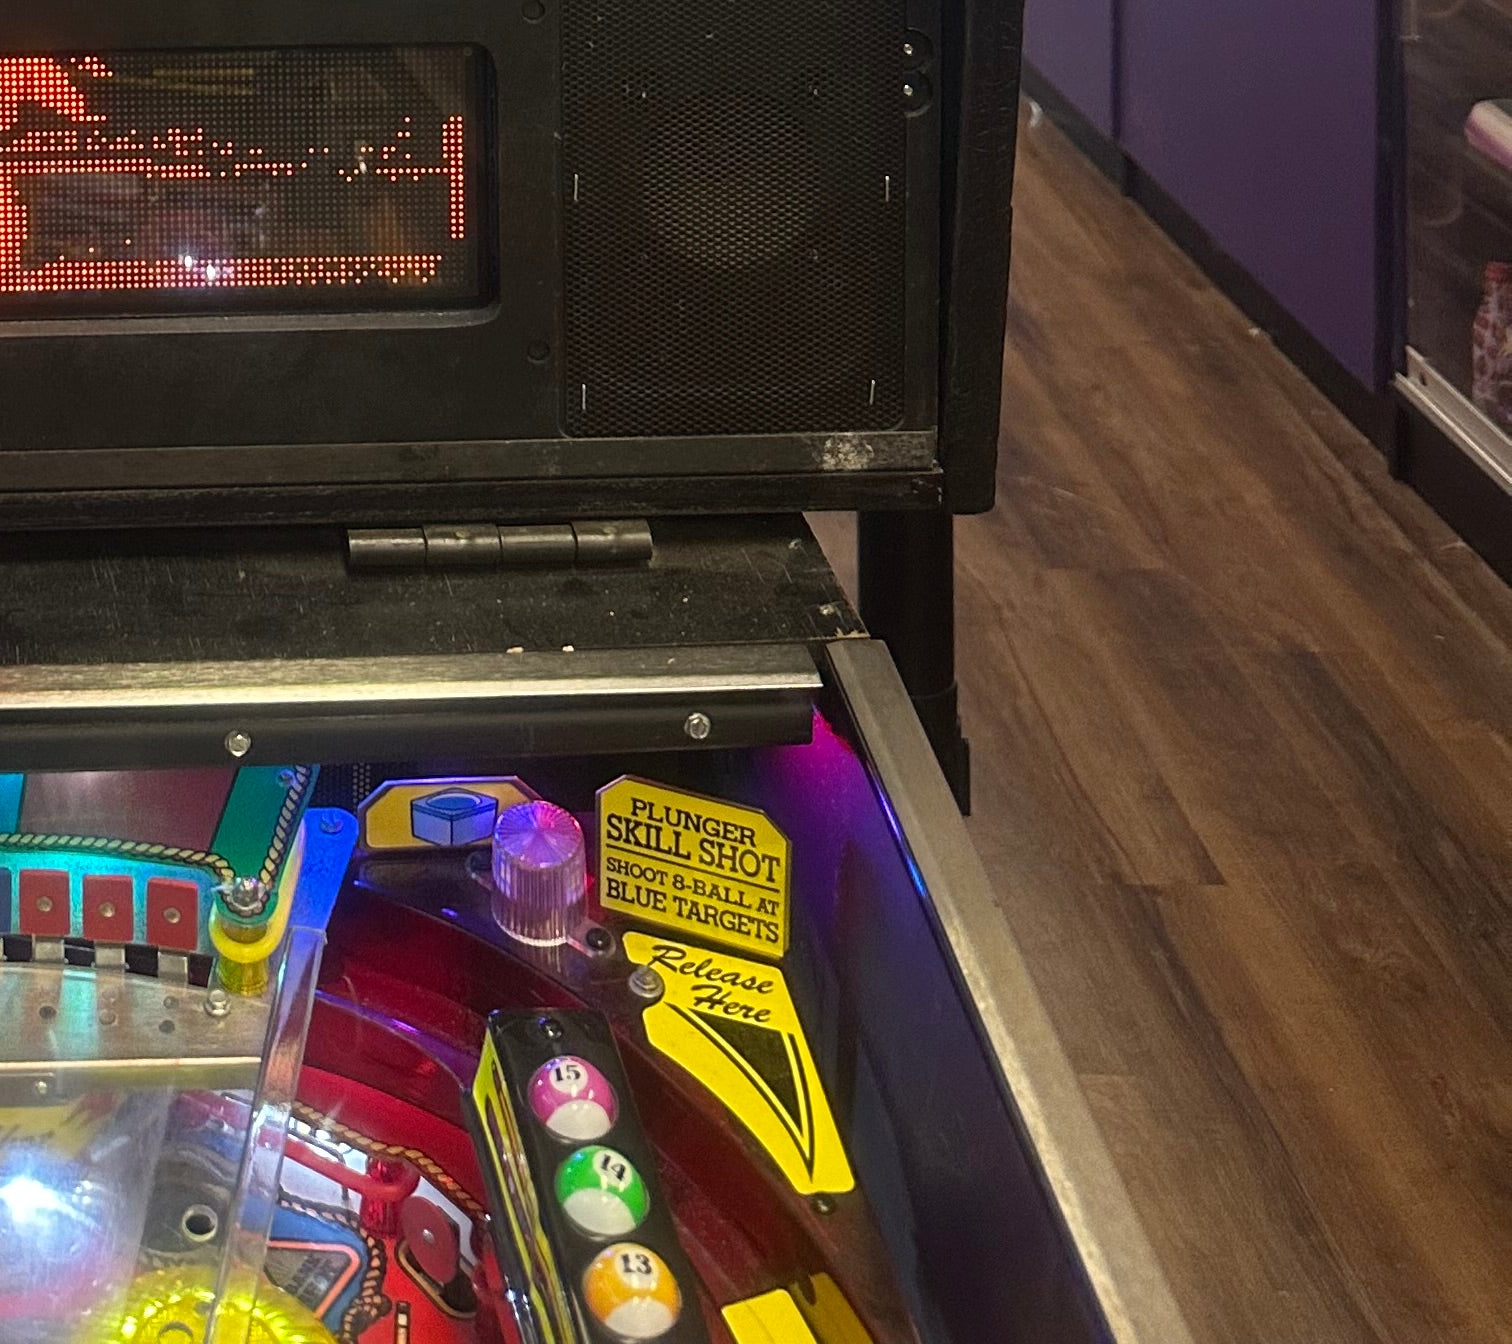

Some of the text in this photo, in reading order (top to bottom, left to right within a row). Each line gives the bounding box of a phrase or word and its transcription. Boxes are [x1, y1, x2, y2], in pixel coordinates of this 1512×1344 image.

[606, 813, 781, 883] SKILL SHOT
[631, 797, 756, 848] PLUNGER
[606, 856, 780, 917] SHOOT 8-BALL AT
[606, 876, 780, 944] BLUE TARGETS
[647, 943, 774, 995] Release
[690, 983, 772, 1023] Here
[553, 1064, 582, 1083] 15
[600, 1154, 627, 1182] 14
[619, 1252, 653, 1275] 13
